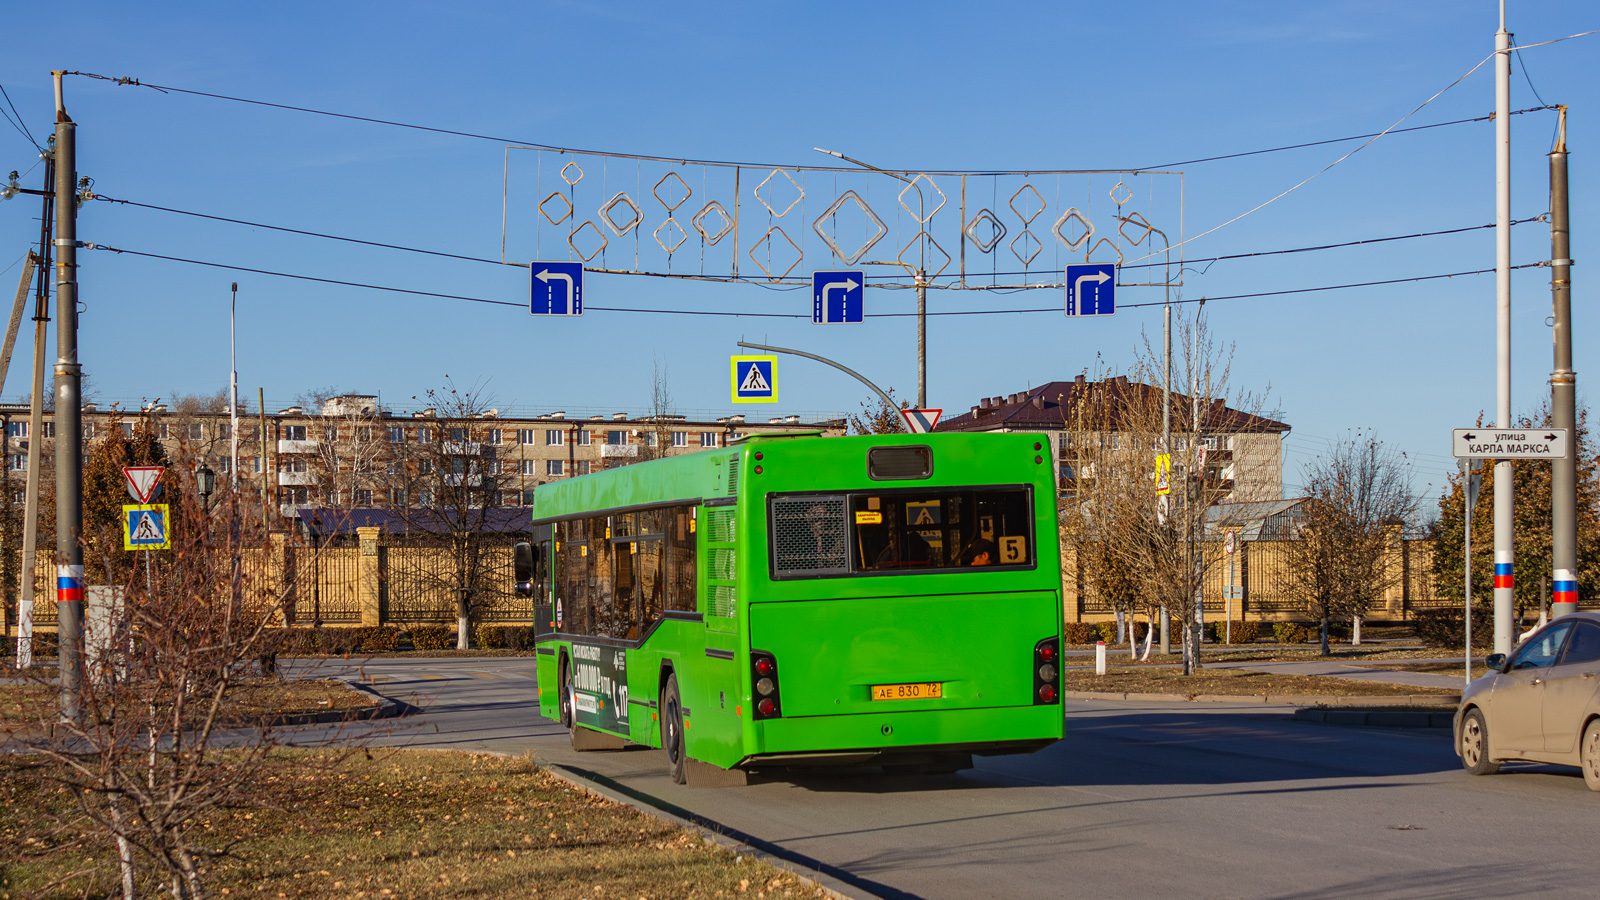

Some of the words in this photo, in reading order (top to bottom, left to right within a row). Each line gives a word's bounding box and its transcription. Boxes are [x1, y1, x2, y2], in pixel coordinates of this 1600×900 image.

[1495, 433, 1526, 442] улица
[1469, 444, 1504, 453] КАРЛА
[1507, 444, 1550, 453] МАРКСА
[1006, 540, 1019, 560] 5
[898, 685, 920, 697] 830
[926, 683, 937, 693] 72
